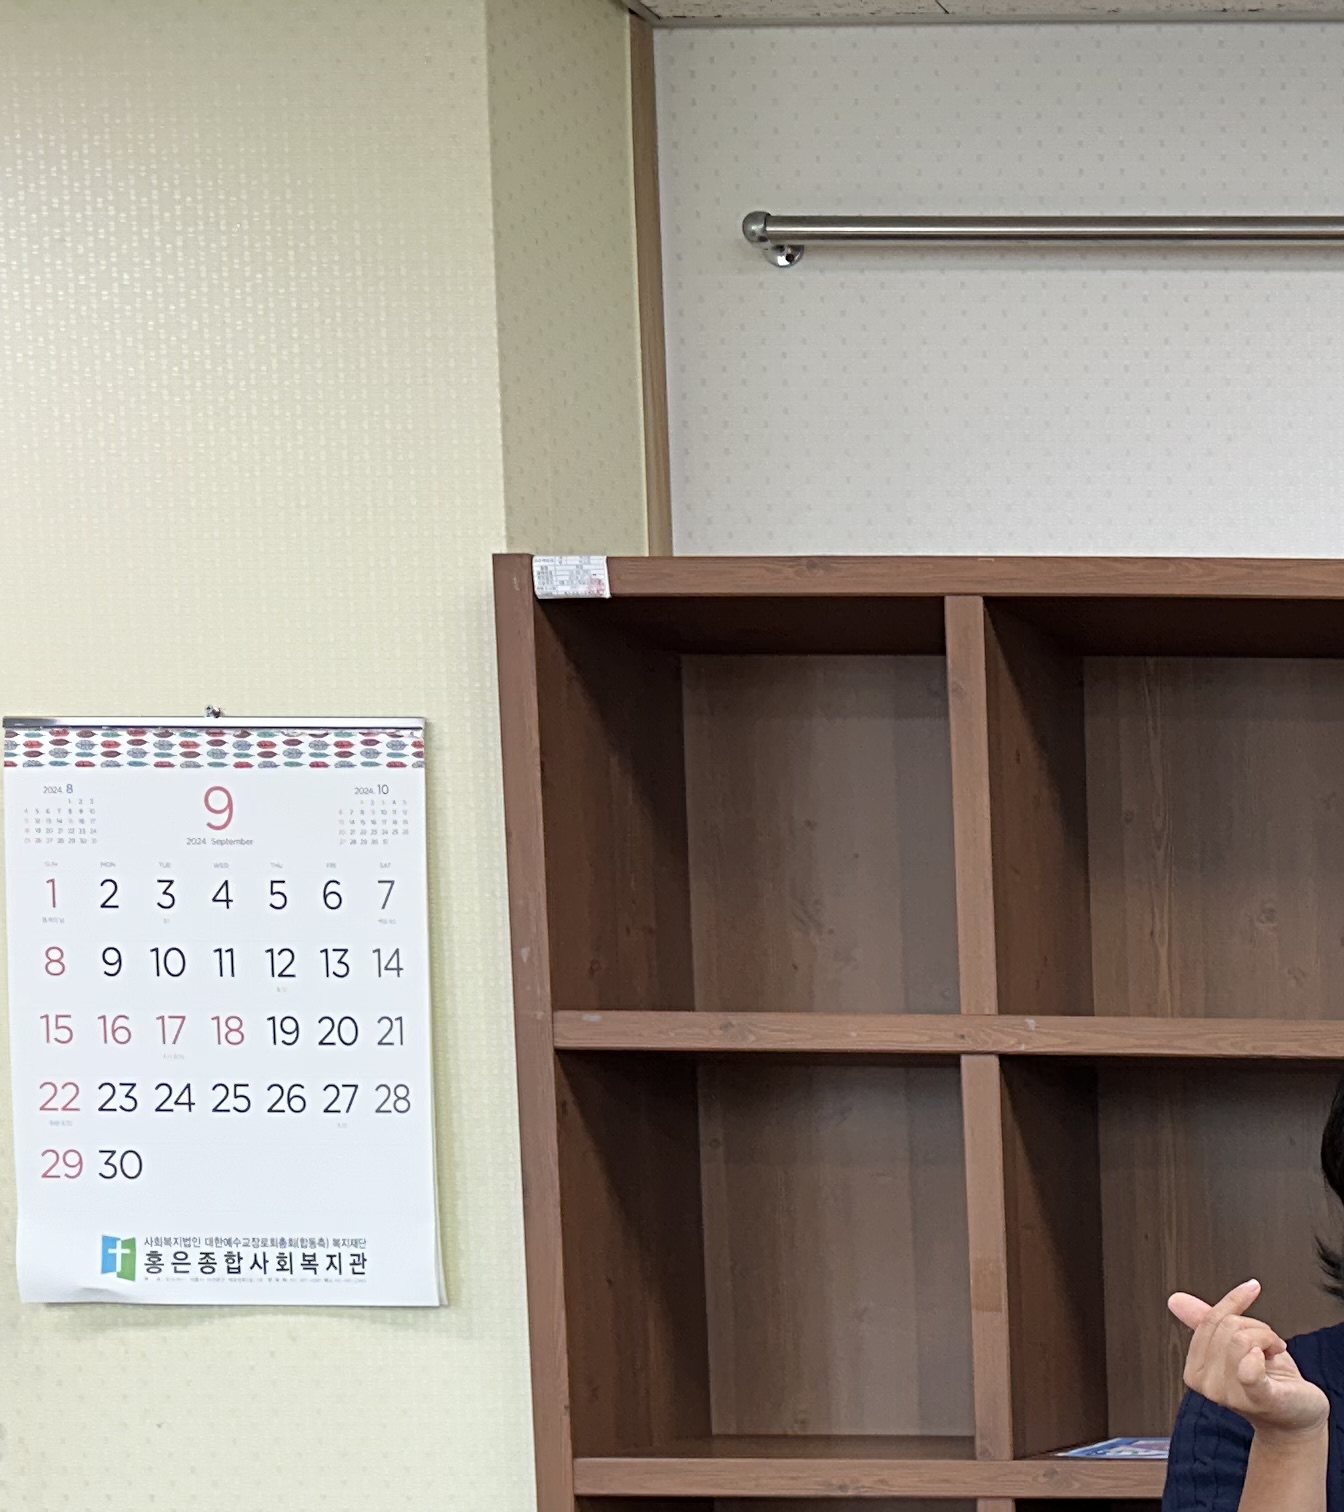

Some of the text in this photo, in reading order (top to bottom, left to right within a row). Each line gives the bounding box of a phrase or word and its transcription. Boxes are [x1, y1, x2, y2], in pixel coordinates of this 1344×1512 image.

[66, 784, 73, 794] 8
[377, 784, 389, 795] 10
[204, 786, 233, 830] 9
[211, 838, 253, 846] September
[46, 879, 395, 910] 1 2 3 4 5 6 7
[45, 946, 404, 978] 8 9 10 11 12 13 14
[40, 1014, 403, 1046] 15 16 17 18 19 20 21
[40, 1082, 410, 1113] 22 23 24 25 26 27 28
[41, 1149, 143, 1179] 29 30
[144, 1236, 201, 1248] 사회복지법인
[333, 1238, 366, 1249] 복지재단
[144, 1250, 367, 1276] 홍은종합사회복지관
